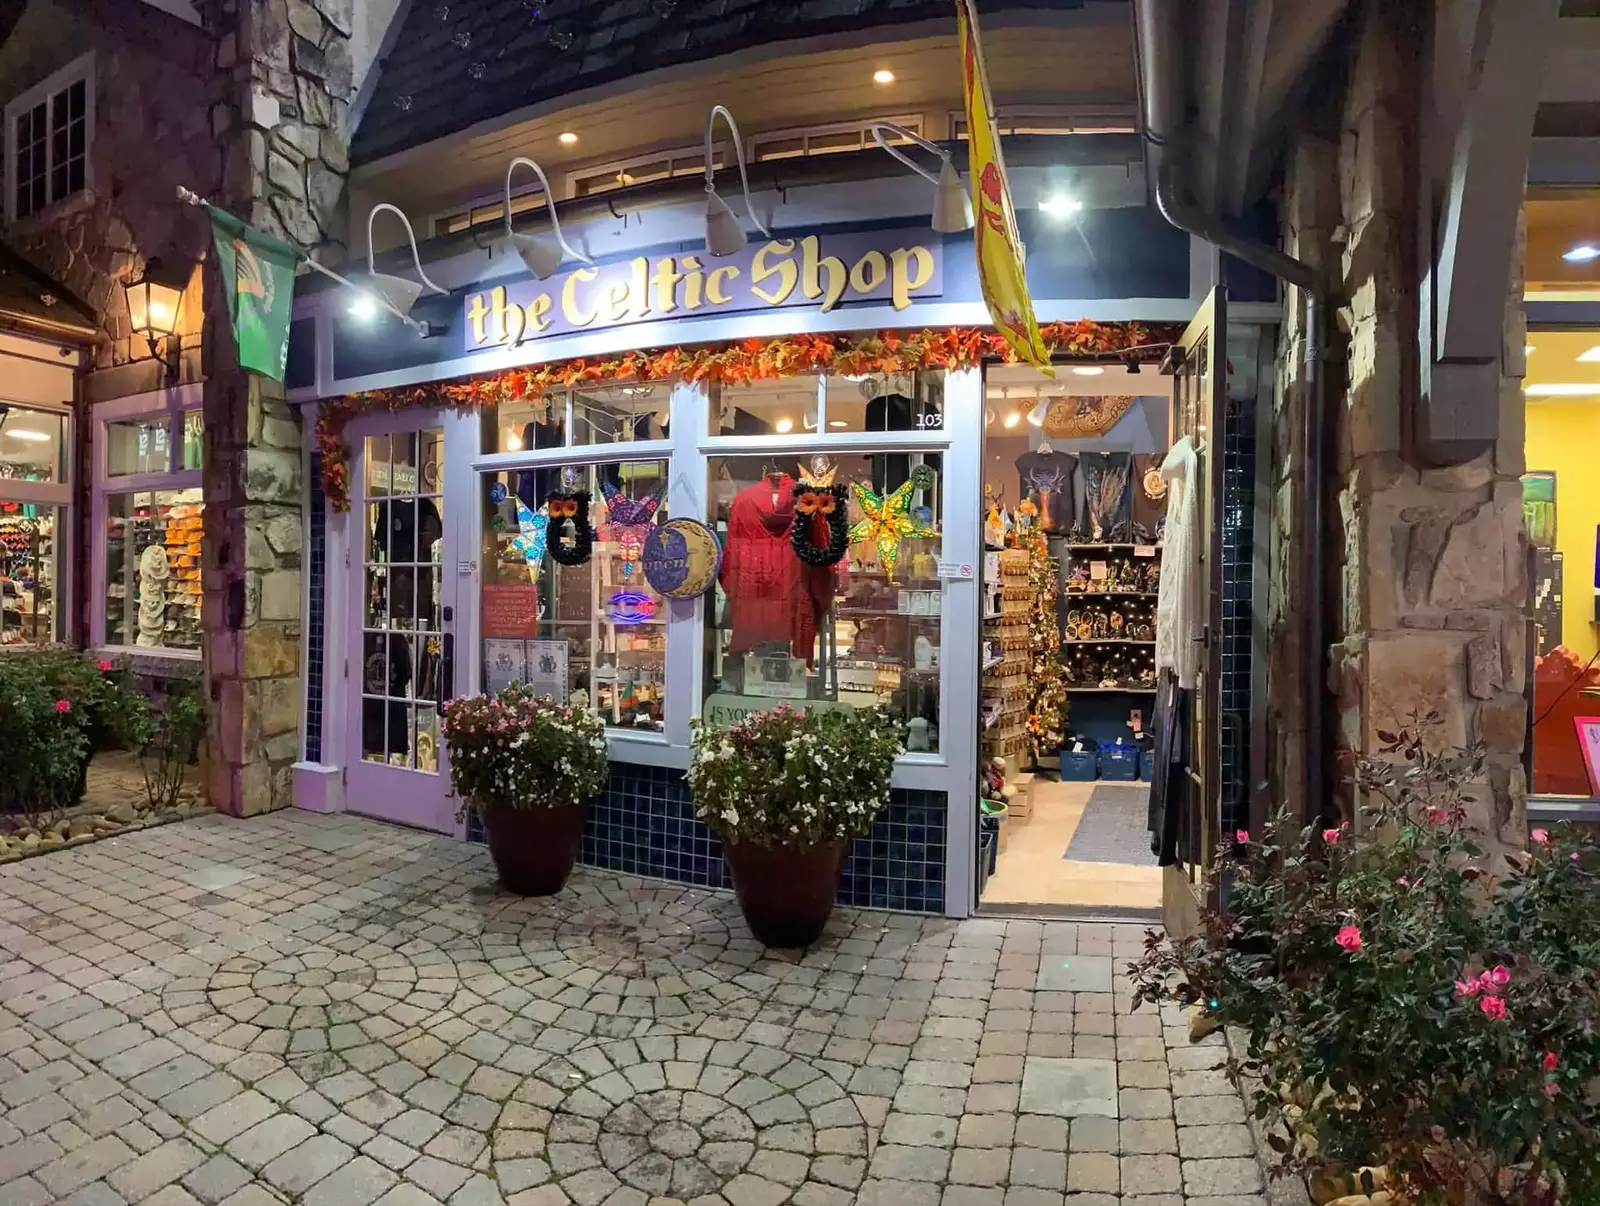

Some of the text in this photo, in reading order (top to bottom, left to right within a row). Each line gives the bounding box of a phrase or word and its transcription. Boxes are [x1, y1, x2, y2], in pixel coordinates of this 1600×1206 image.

[467, 235, 936, 349] the Celtic Shop
[916, 413, 943, 427] 103
